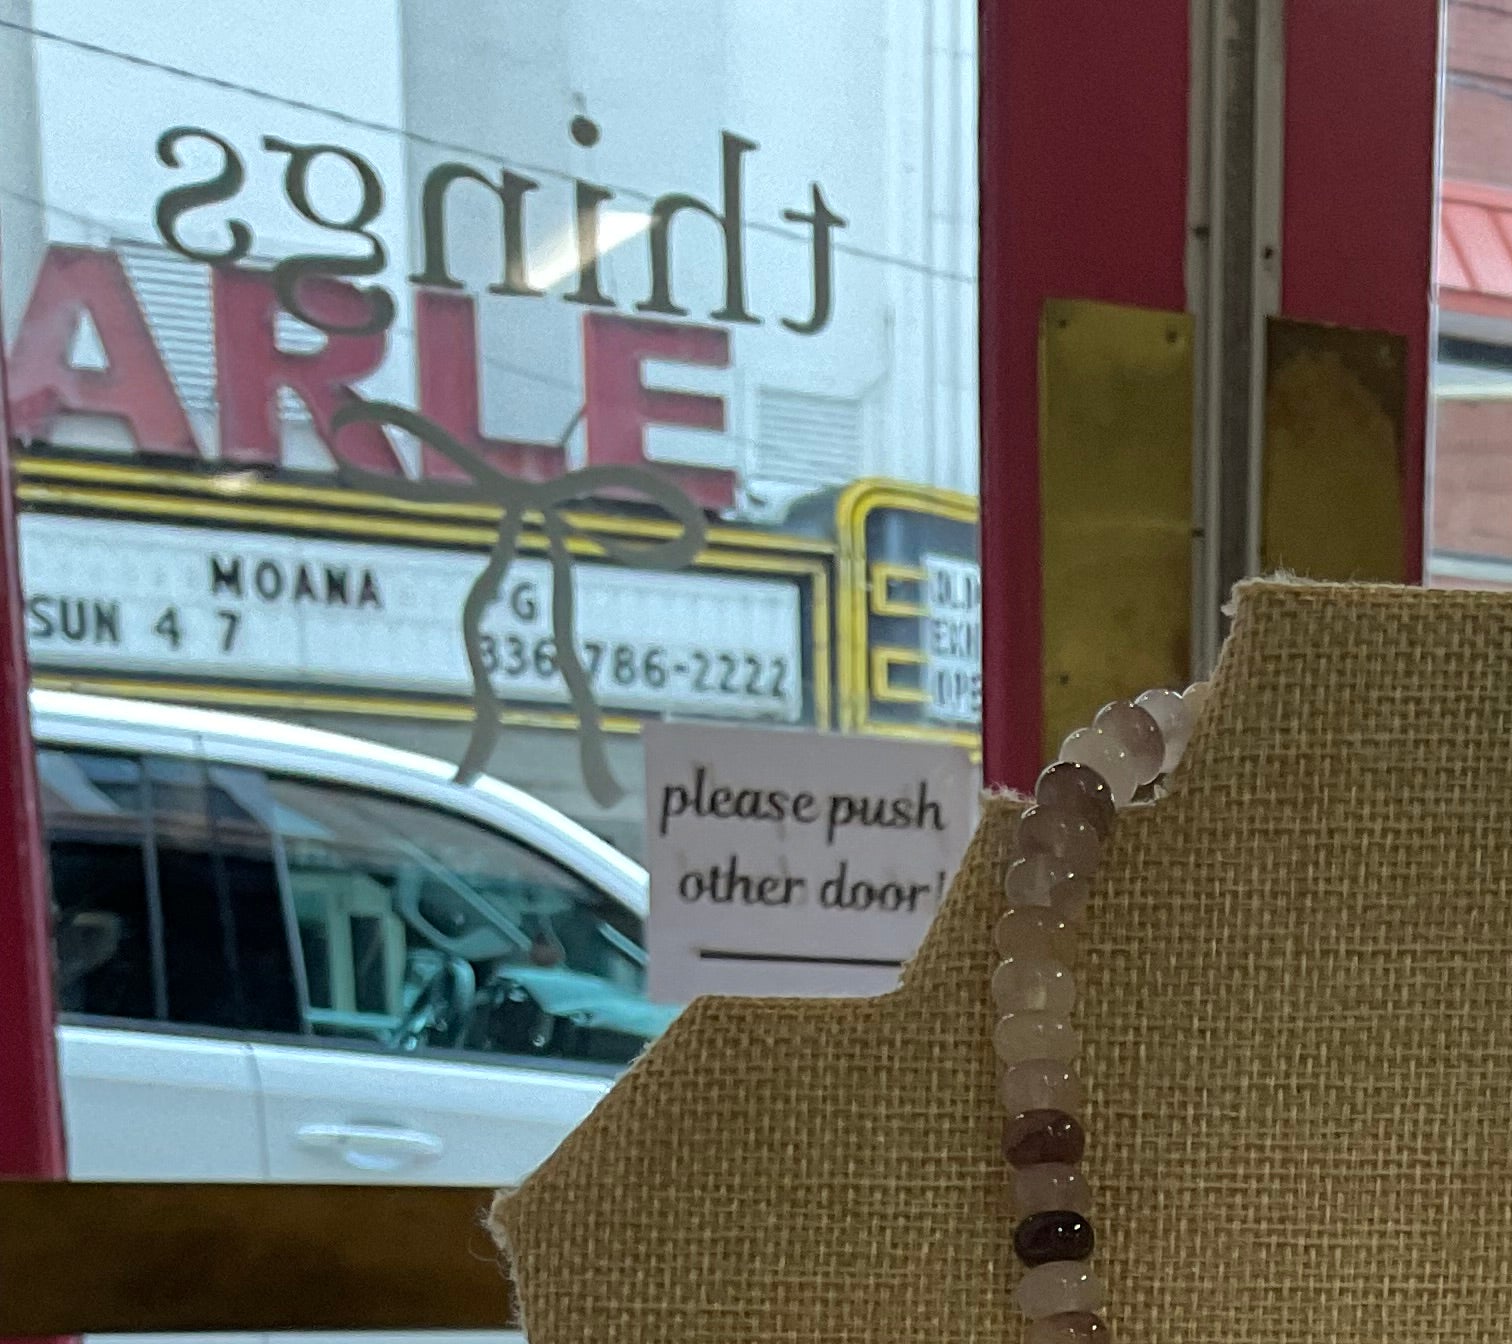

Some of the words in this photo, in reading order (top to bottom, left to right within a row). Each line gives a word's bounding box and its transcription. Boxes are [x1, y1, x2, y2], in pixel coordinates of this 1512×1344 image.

[8, 243, 738, 512] ARLE
[210, 553, 383, 607] MOANA
[511, 581, 537, 621] G
[30, 597, 120, 643] SUN
[154, 606, 181, 650] 4
[219, 610, 240, 651] 7
[659, 764, 818, 837] please
[826, 779, 945, 846] push
[680, 853, 805, 905] other
